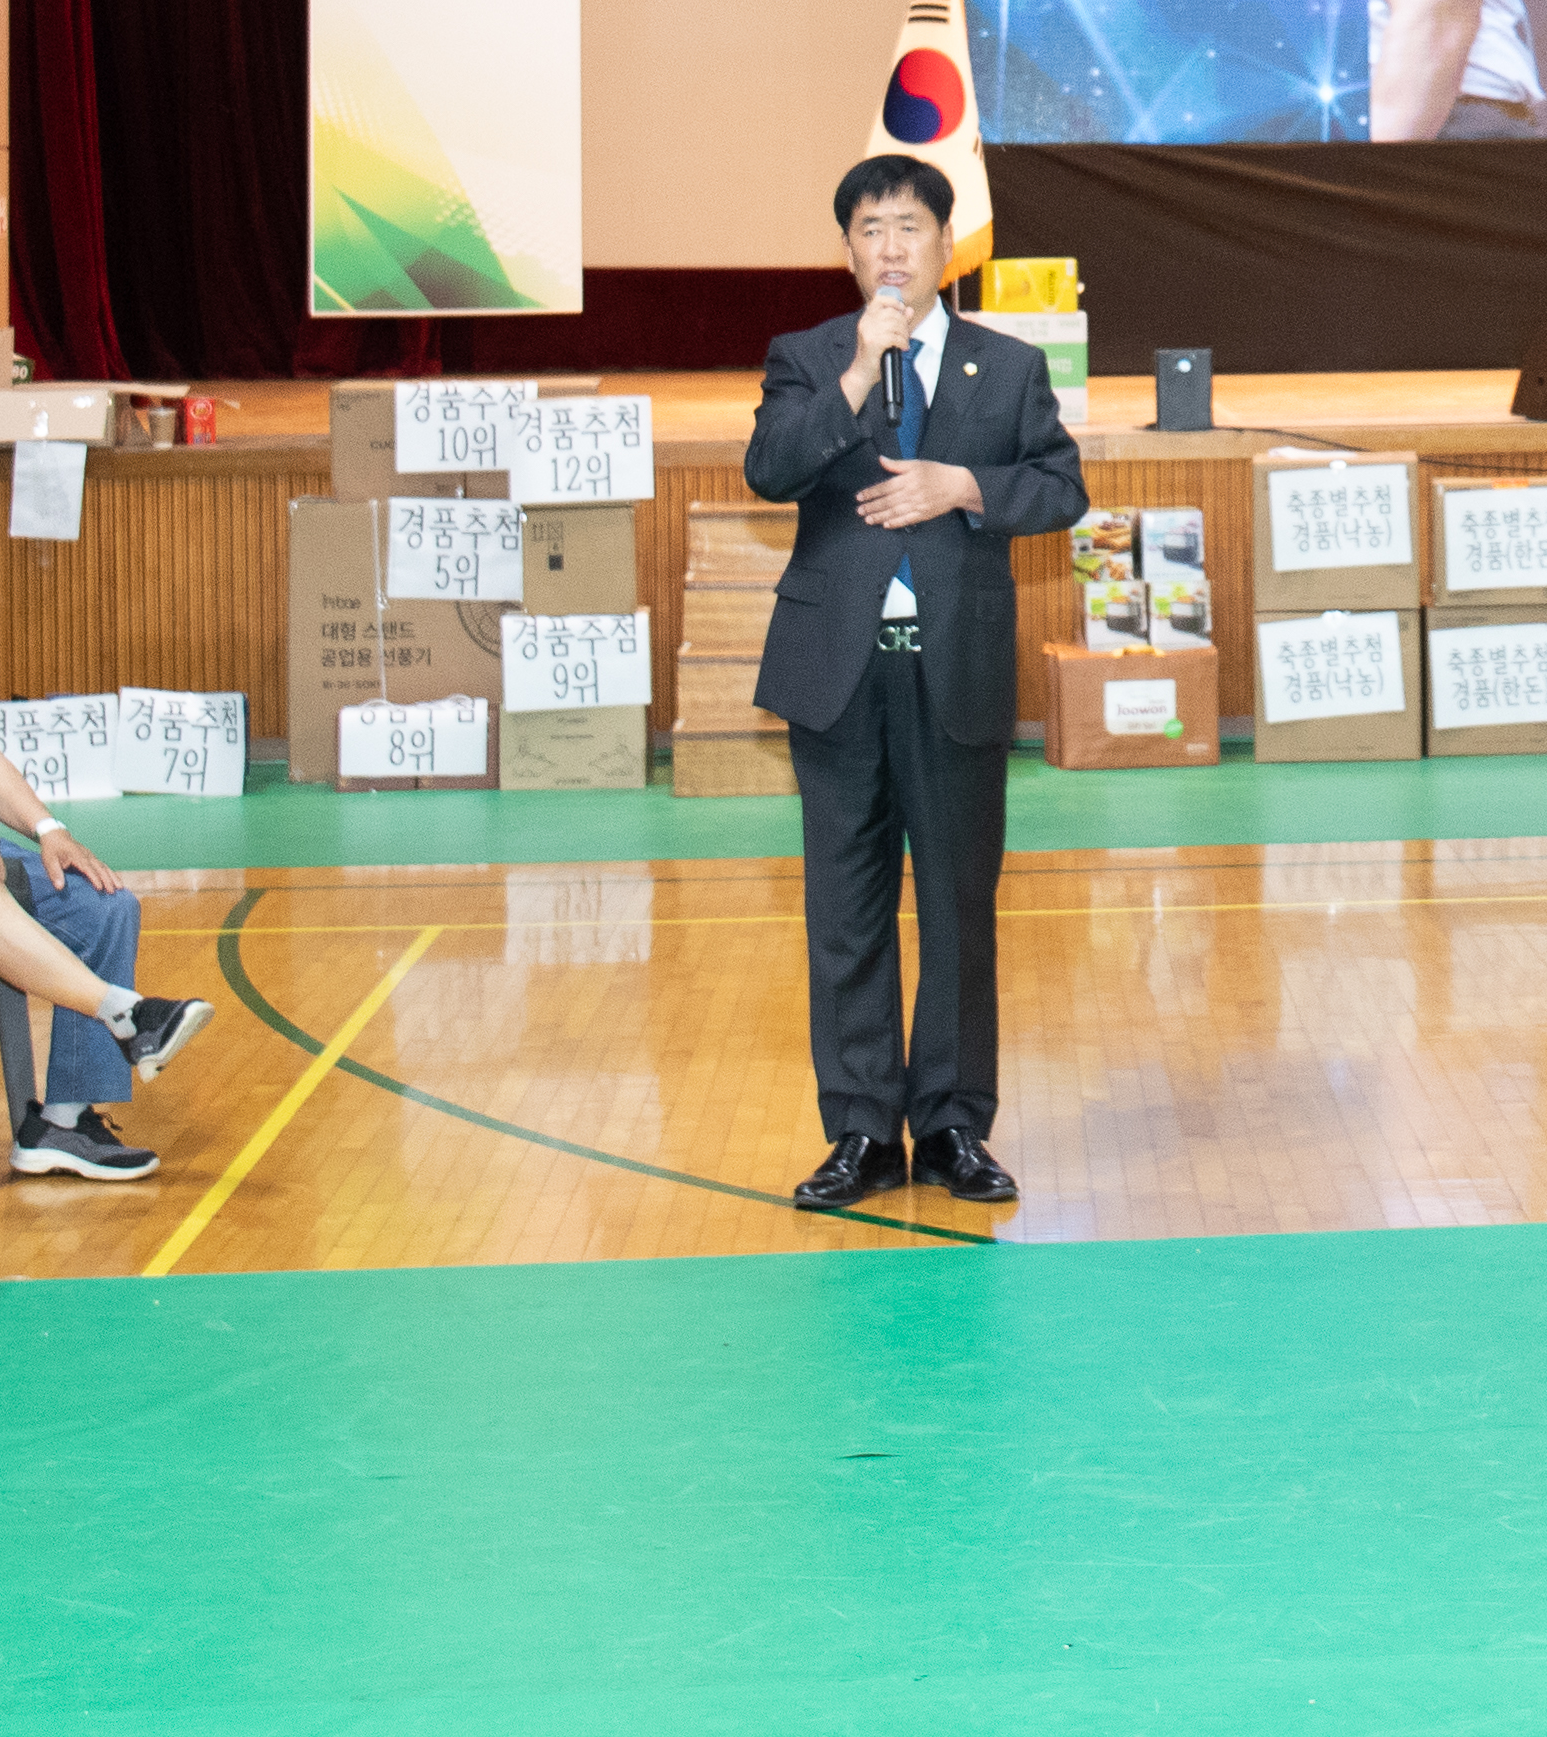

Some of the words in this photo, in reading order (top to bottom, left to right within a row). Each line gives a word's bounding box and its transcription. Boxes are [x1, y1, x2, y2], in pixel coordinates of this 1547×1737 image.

[439, 423, 497, 467] 10위
[519, 403, 641, 452] 경품추첨
[550, 453, 612, 497] 12위
[1287, 484, 1391, 520] 축종별추첨
[398, 505, 522, 551] 경품추첨
[1292, 516, 1392, 553] 경품(낙농)
[434, 551, 480, 596] 5위
[321, 622, 357, 641] 대형
[1277, 632, 1382, 671] 축종별추첨
[554, 659, 599, 704] 9위
[1284, 665, 1384, 704] 경품(낙농)
[127, 696, 238, 744] 경품추첨
[163, 747, 208, 792] 7위
[389, 726, 435, 772] 8위
[22, 753, 70, 796] 6위
